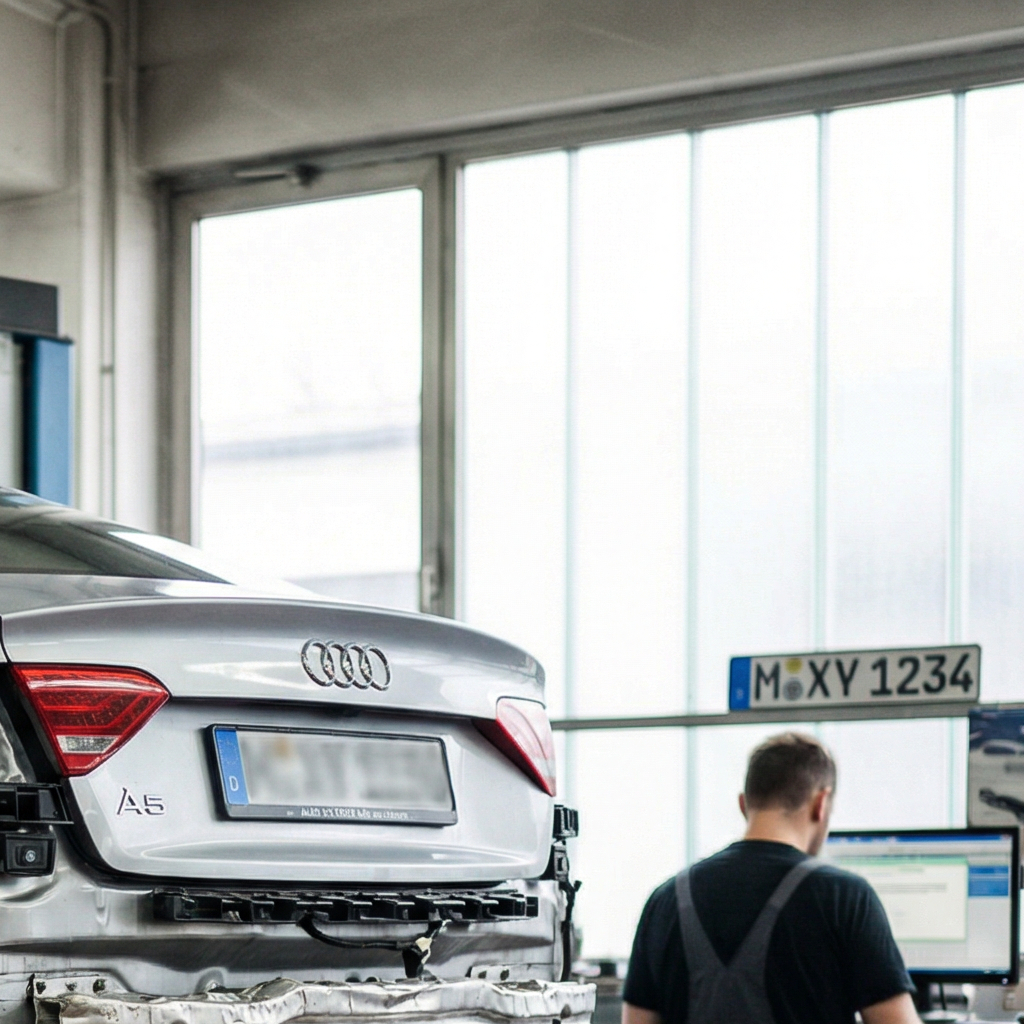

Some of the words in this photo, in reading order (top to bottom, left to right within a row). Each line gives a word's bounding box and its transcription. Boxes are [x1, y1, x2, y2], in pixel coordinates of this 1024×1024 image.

[755, 662, 780, 700] M
[808, 657, 859, 697] XY
[870, 653, 973, 696] 1234
[229, 775, 239, 792] D
[116, 787, 165, 815] A5
